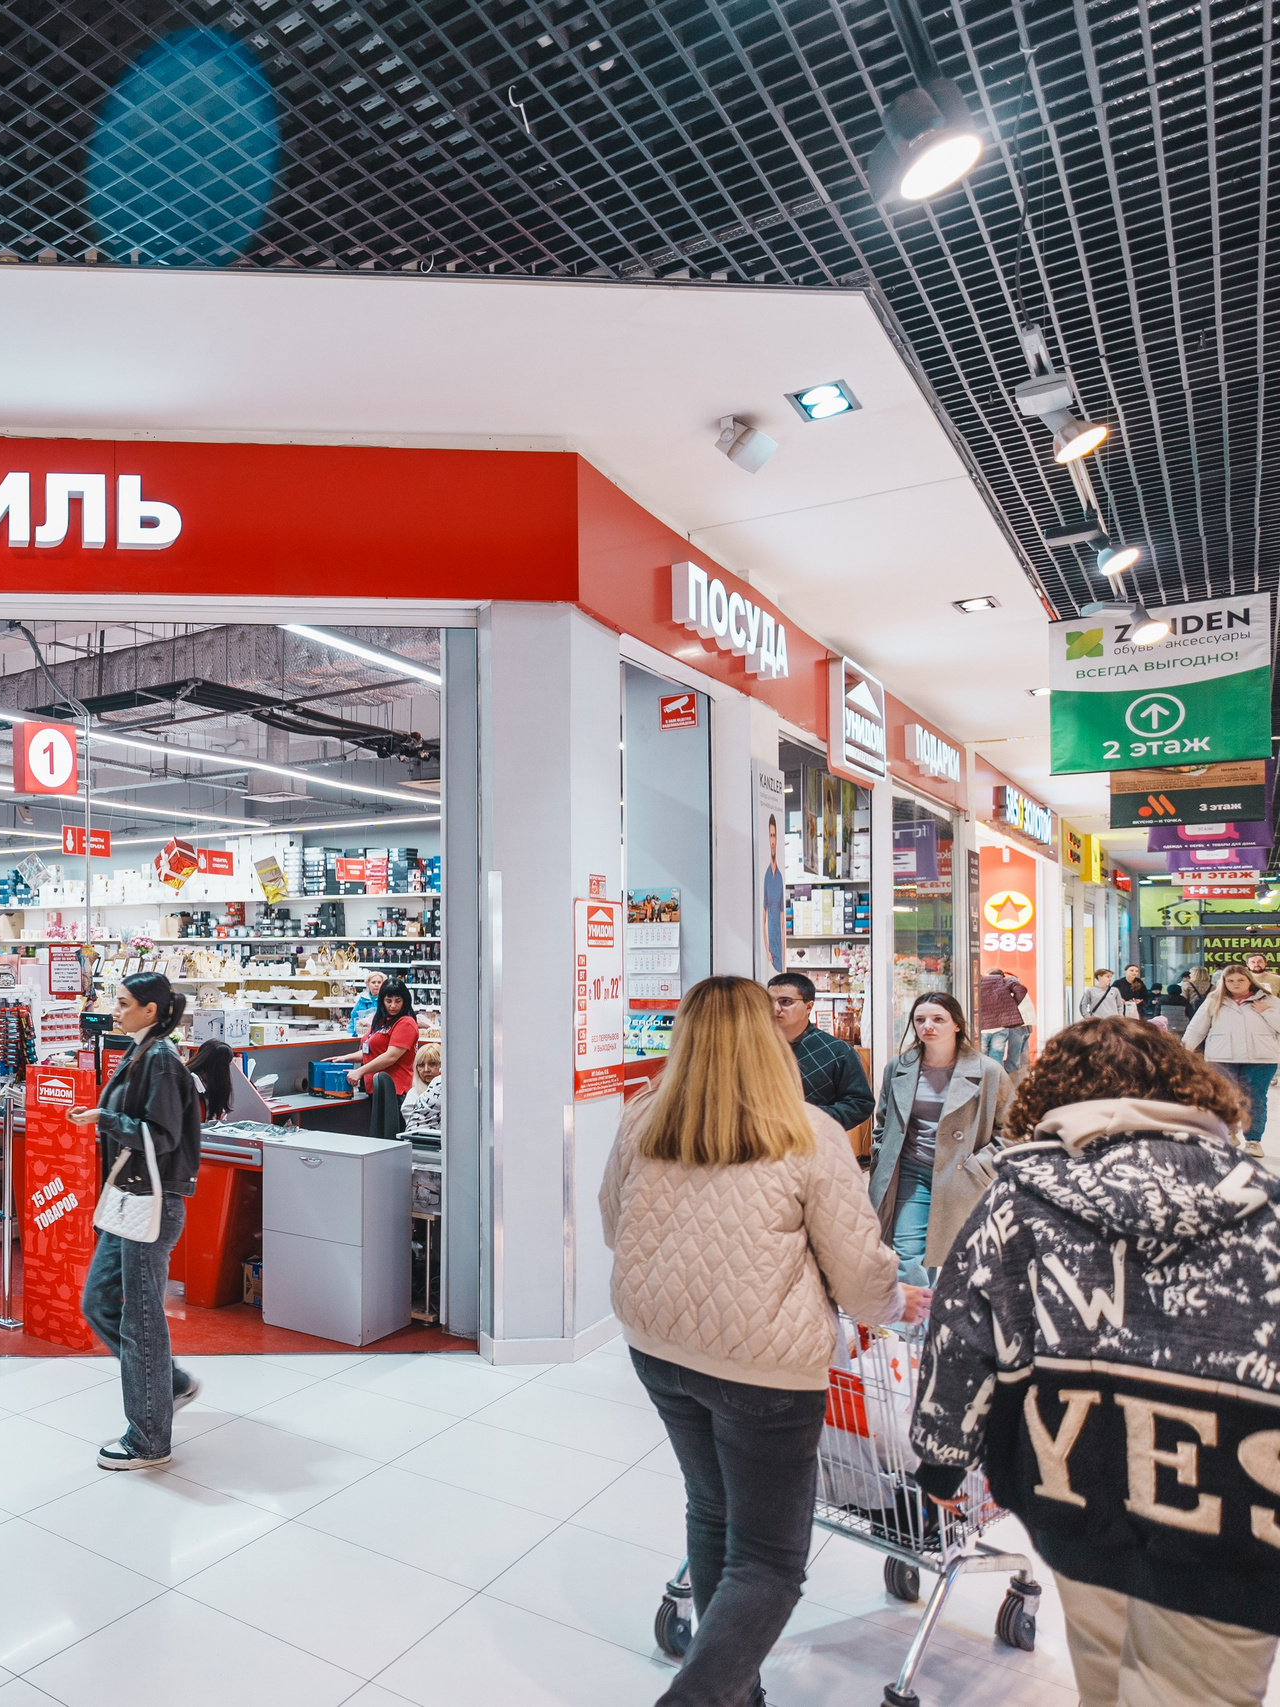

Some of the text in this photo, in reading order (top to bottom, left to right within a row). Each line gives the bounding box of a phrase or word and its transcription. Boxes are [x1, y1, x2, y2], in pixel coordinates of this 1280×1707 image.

[686, 560, 790, 679] ПОСУДА
[1114, 607, 1252, 643] ZDEN
[1113, 629, 1252, 656] обувь аксессуары
[1075, 651, 1239, 680] ВСЕГДА ВЫГОДНО!
[845, 706, 884, 756] УНИДОМ
[42, 741, 55, 775] 1
[915, 723, 961, 783] ПОДАРКИ
[1102, 736, 1211, 760] 2 этаж
[759, 772, 784, 795] KANZLER
[1198, 802, 1242, 812] 3 этаж
[1207, 871, 1254, 879] этаж
[1188, 886, 1251, 895] 1-й этаж
[588, 924, 614, 938] УНИДОМ
[983, 932, 1034, 952] 585
[579, 970, 585, 979] ВТ
[39, 1087, 73, 1099] УНИДОМ
[31, 1177, 65, 1209] 15 000
[33, 1192, 79, 1231] ТОВАРОВ
